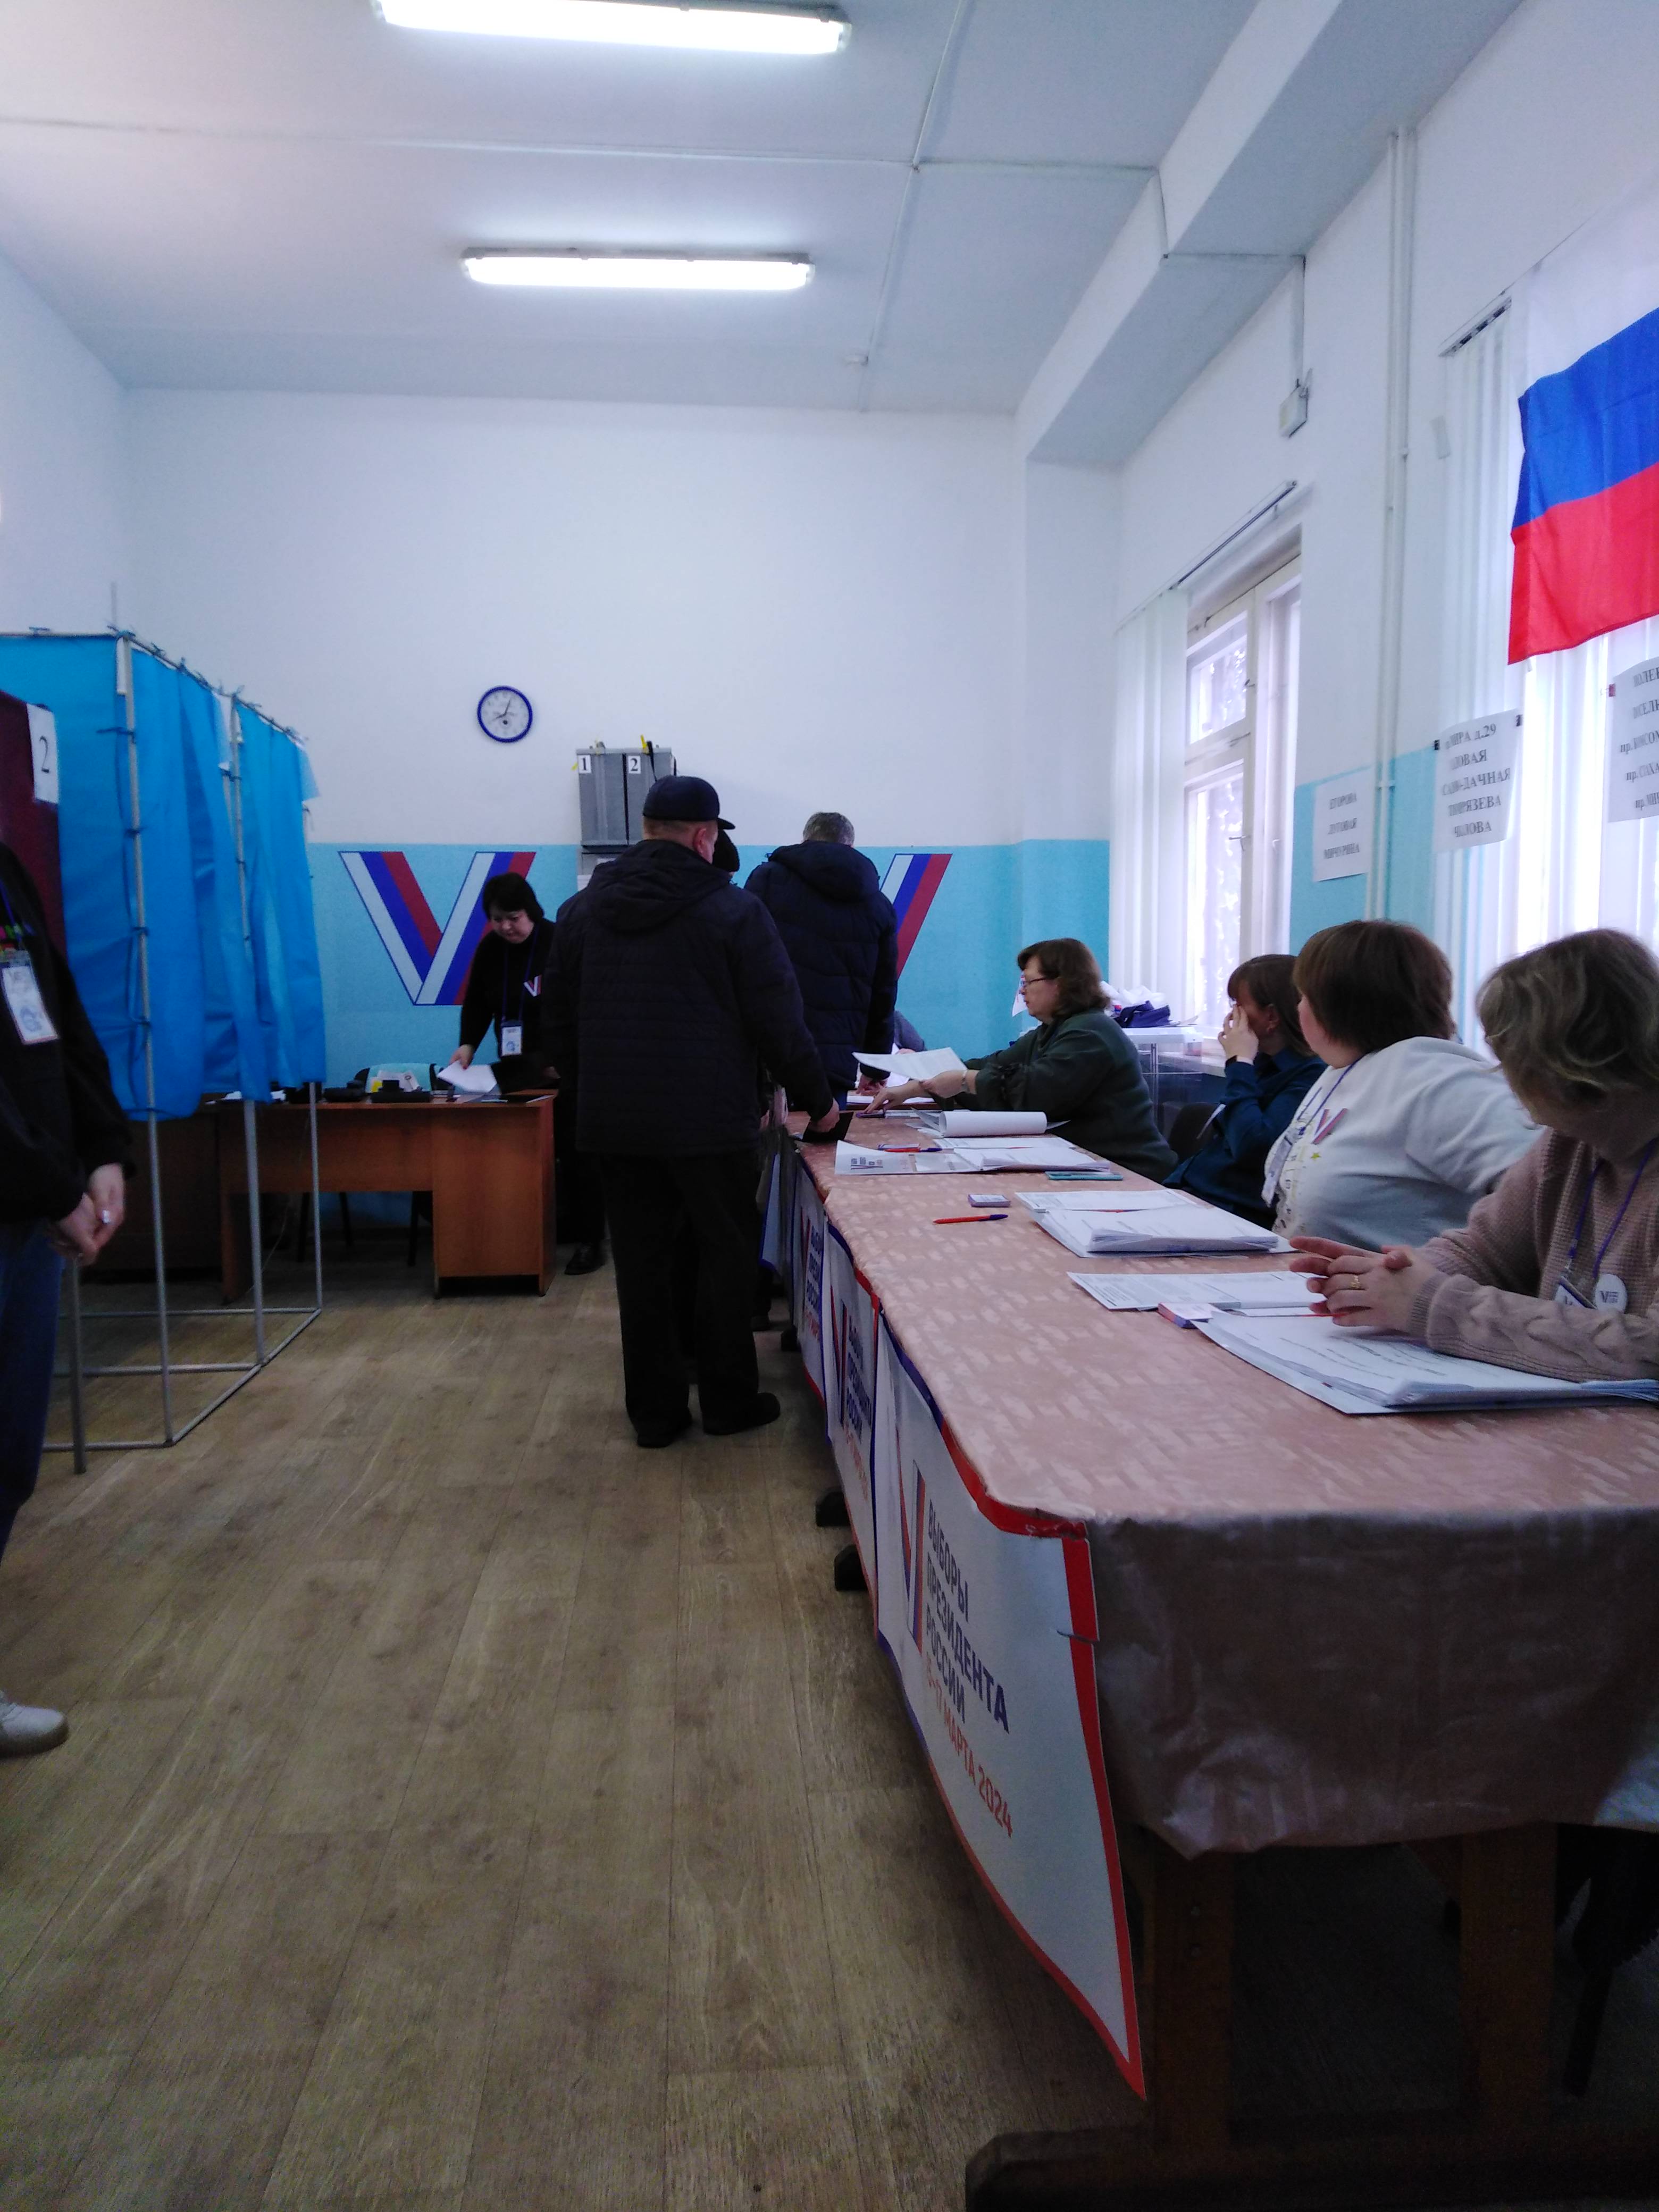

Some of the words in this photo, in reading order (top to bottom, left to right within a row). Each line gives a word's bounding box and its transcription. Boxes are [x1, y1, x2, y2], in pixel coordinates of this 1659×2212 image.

[39, 735, 50, 774] 2
[582, 758, 587, 771] 1
[630, 758, 639, 772] 2
[1474, 723, 1496, 740] д.29
[927, 1498, 969, 1622] ВЫБОРЫ
[926, 1551, 1010, 1735] ПРЕЗИДЕНТА
[926, 1602, 966, 1724] РОССИИ
[943, 1697, 976, 1786] МАРТА
[978, 1764, 1013, 1839] 2024
